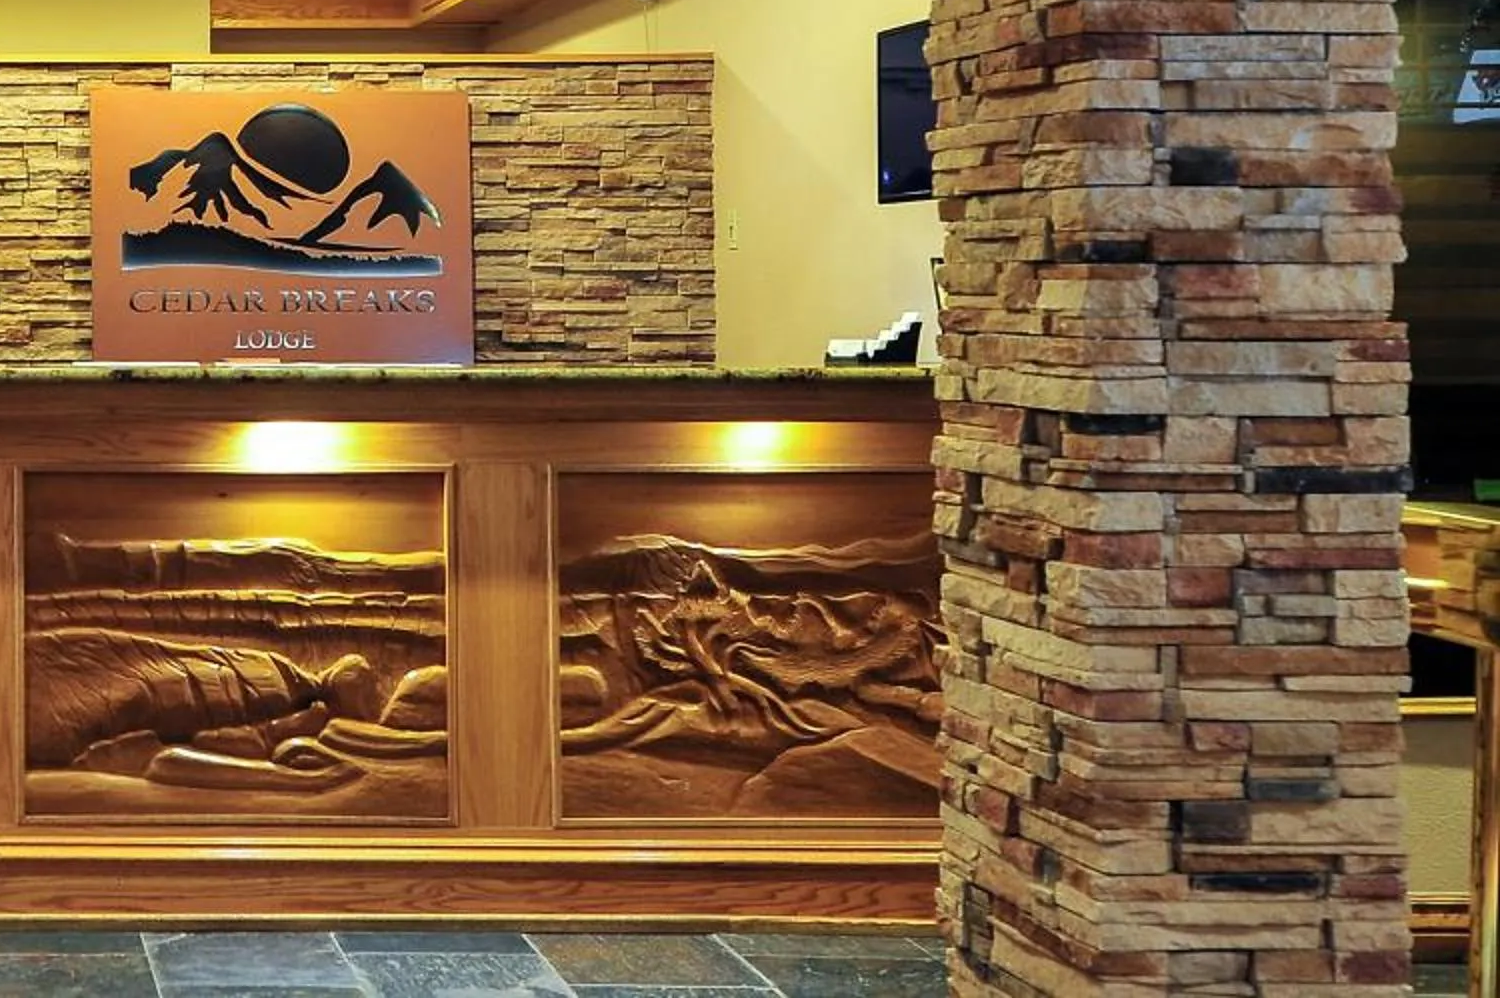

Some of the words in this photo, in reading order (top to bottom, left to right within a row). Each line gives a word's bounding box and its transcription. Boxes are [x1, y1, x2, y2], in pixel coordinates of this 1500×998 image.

[128, 288, 268, 314] CEDAR
[279, 288, 437, 314] BREAKS
[233, 329, 316, 350] LODGE
